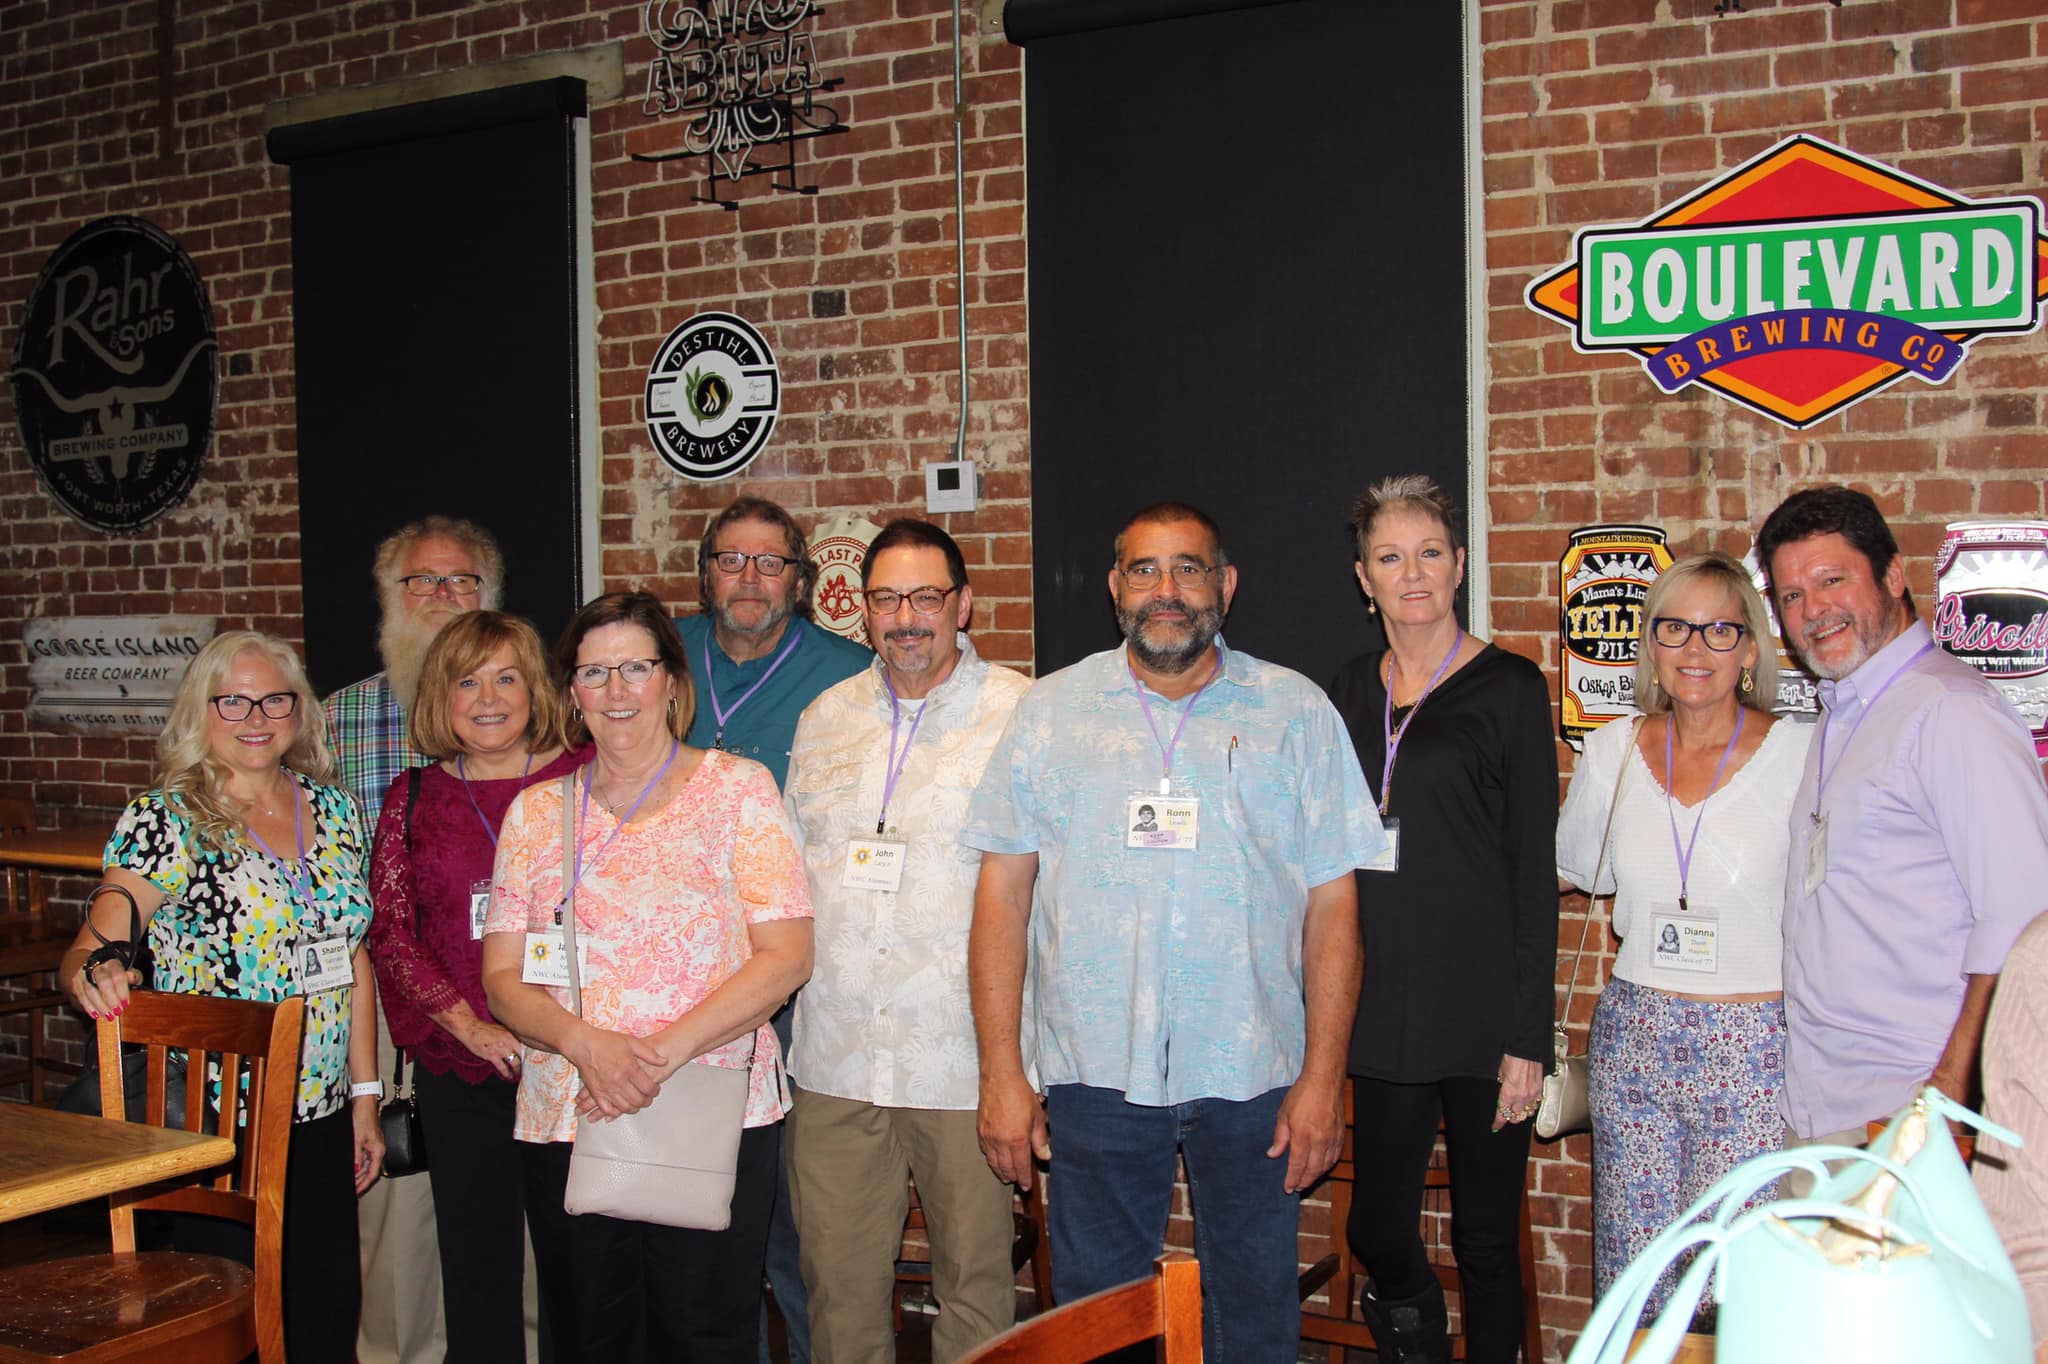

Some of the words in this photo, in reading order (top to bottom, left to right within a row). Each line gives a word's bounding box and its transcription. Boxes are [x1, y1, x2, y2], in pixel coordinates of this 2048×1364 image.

[642, 31, 824, 116] ABITA
[1600, 226, 2016, 325] BOULEVARD
[46, 251, 173, 375] Rahr
[670, 331, 748, 368] DESTIHL
[1664, 316, 1881, 381] BREWING
[52, 435, 116, 458] BREWING
[119, 427, 185, 450] COMPANY
[667, 420, 751, 459] BREWERY
[94, 499, 142, 515] WORTH
[819, 548, 851, 564] LAST
[1581, 585, 1624, 604] Mama's
[34, 637, 112, 657] GOOSE
[115, 636, 200, 657] ISLAND
[1596, 641, 1639, 660] PILS
[64, 667, 97, 680] BEER
[102, 666, 170, 680] COMPANY
[66, 713, 116, 725] CHICAGO
[124, 714, 146, 725] EST.
[1166, 808, 1191, 817] Ronn
[875, 848, 894, 858] John
[1684, 926, 1715, 938] Dianna
[321, 944, 346, 954] Sharon
